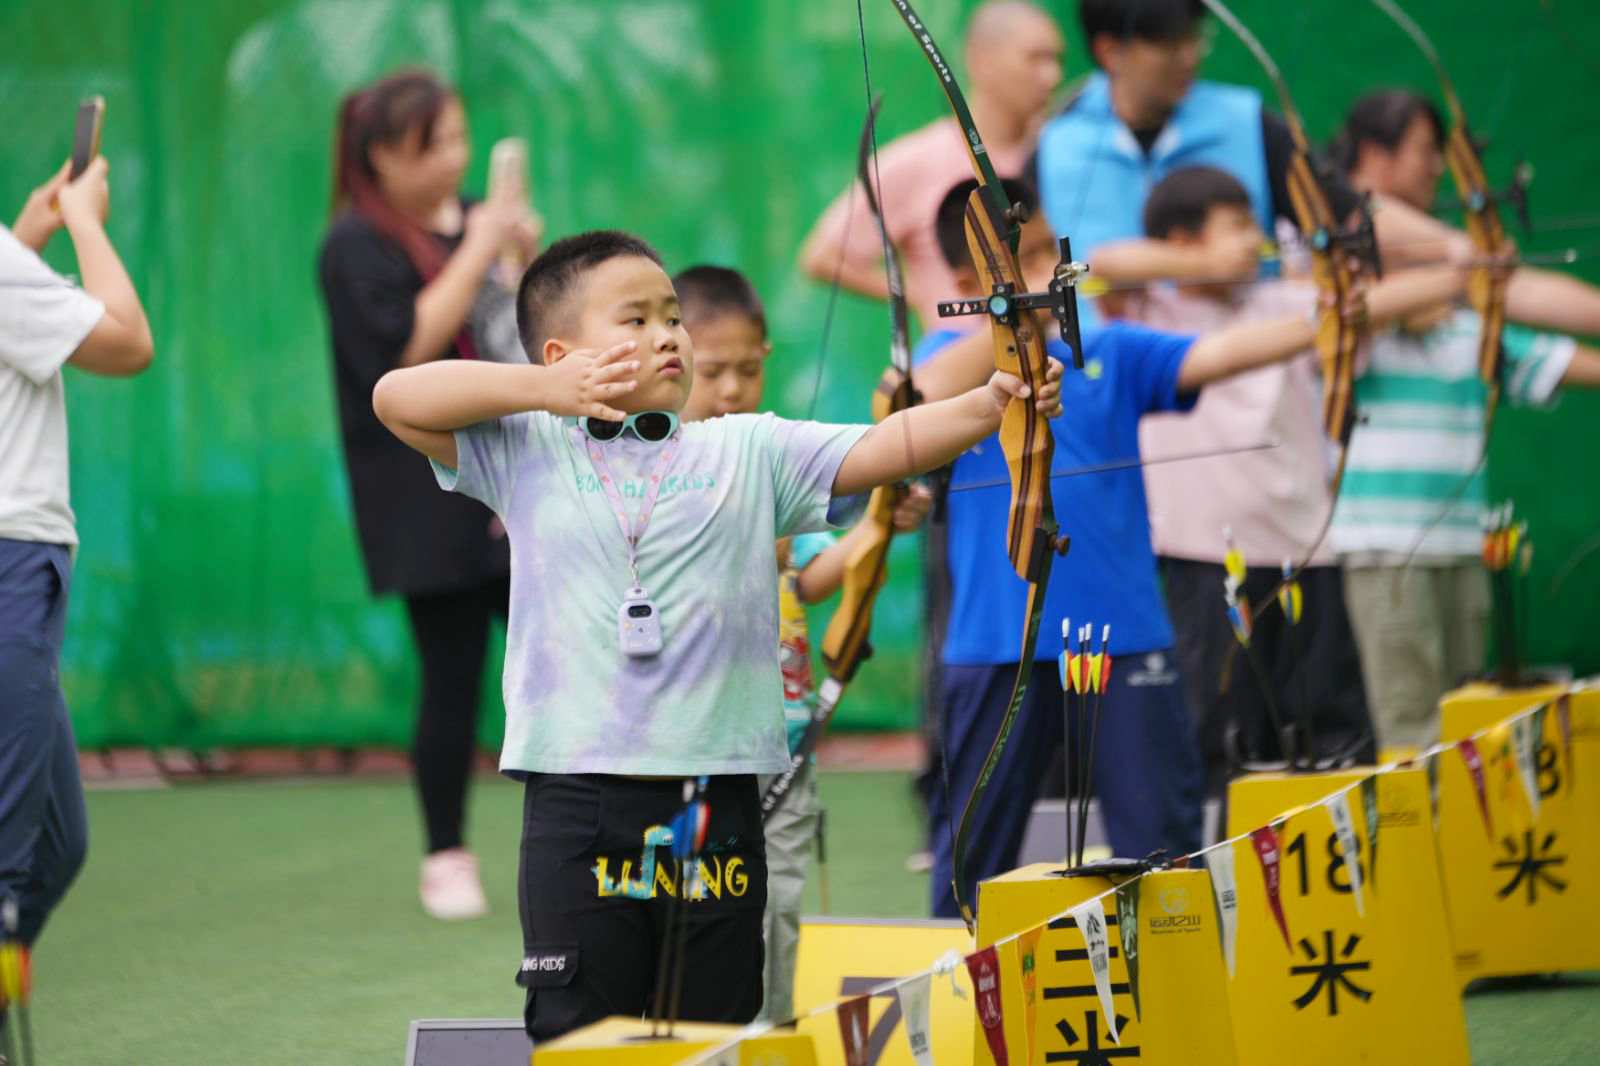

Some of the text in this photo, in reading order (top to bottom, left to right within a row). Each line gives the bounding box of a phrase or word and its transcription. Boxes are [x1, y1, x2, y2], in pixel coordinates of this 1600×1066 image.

[908, 14, 951, 83] of Sports
[1286, 832, 1365, 897] 18
[1491, 830, 1569, 905] 米
[539, 955, 566, 971] KIDS
[1288, 930, 1374, 1016] 米
